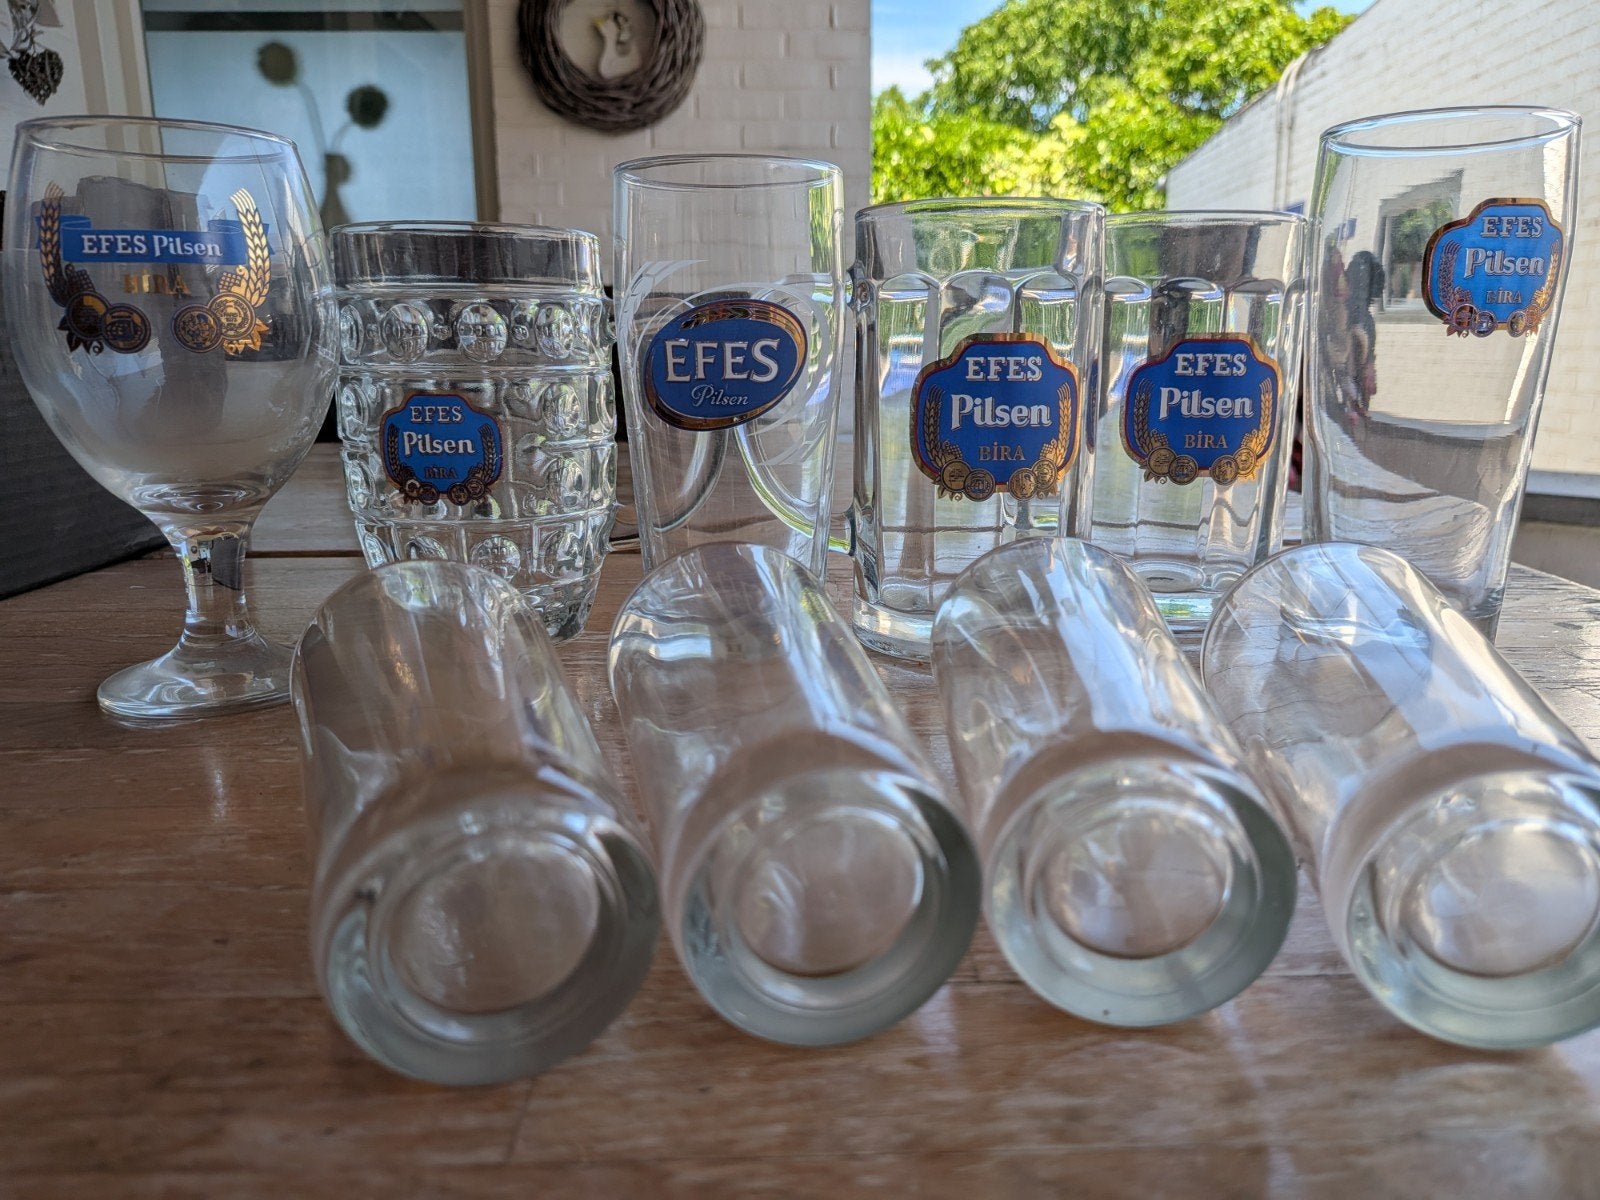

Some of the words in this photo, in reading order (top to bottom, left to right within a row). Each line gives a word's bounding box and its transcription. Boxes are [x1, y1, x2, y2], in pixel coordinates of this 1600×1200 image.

[1480, 216, 1543, 238] EFES
[81, 234, 148, 255] EFES
[153, 234, 223, 257] Pilsen
[1463, 247, 1545, 279] Pilsen
[665, 338, 781, 383] EFES
[965, 356, 1043, 382] EFES
[1174, 353, 1248, 377] EFES
[691, 384, 749, 407] Pilsen
[1158, 387, 1255, 422] Pilsen
[410, 405, 464, 424] EFES
[950, 394, 1053, 432] Pilsen
[403, 431, 475, 457] Pilsen
